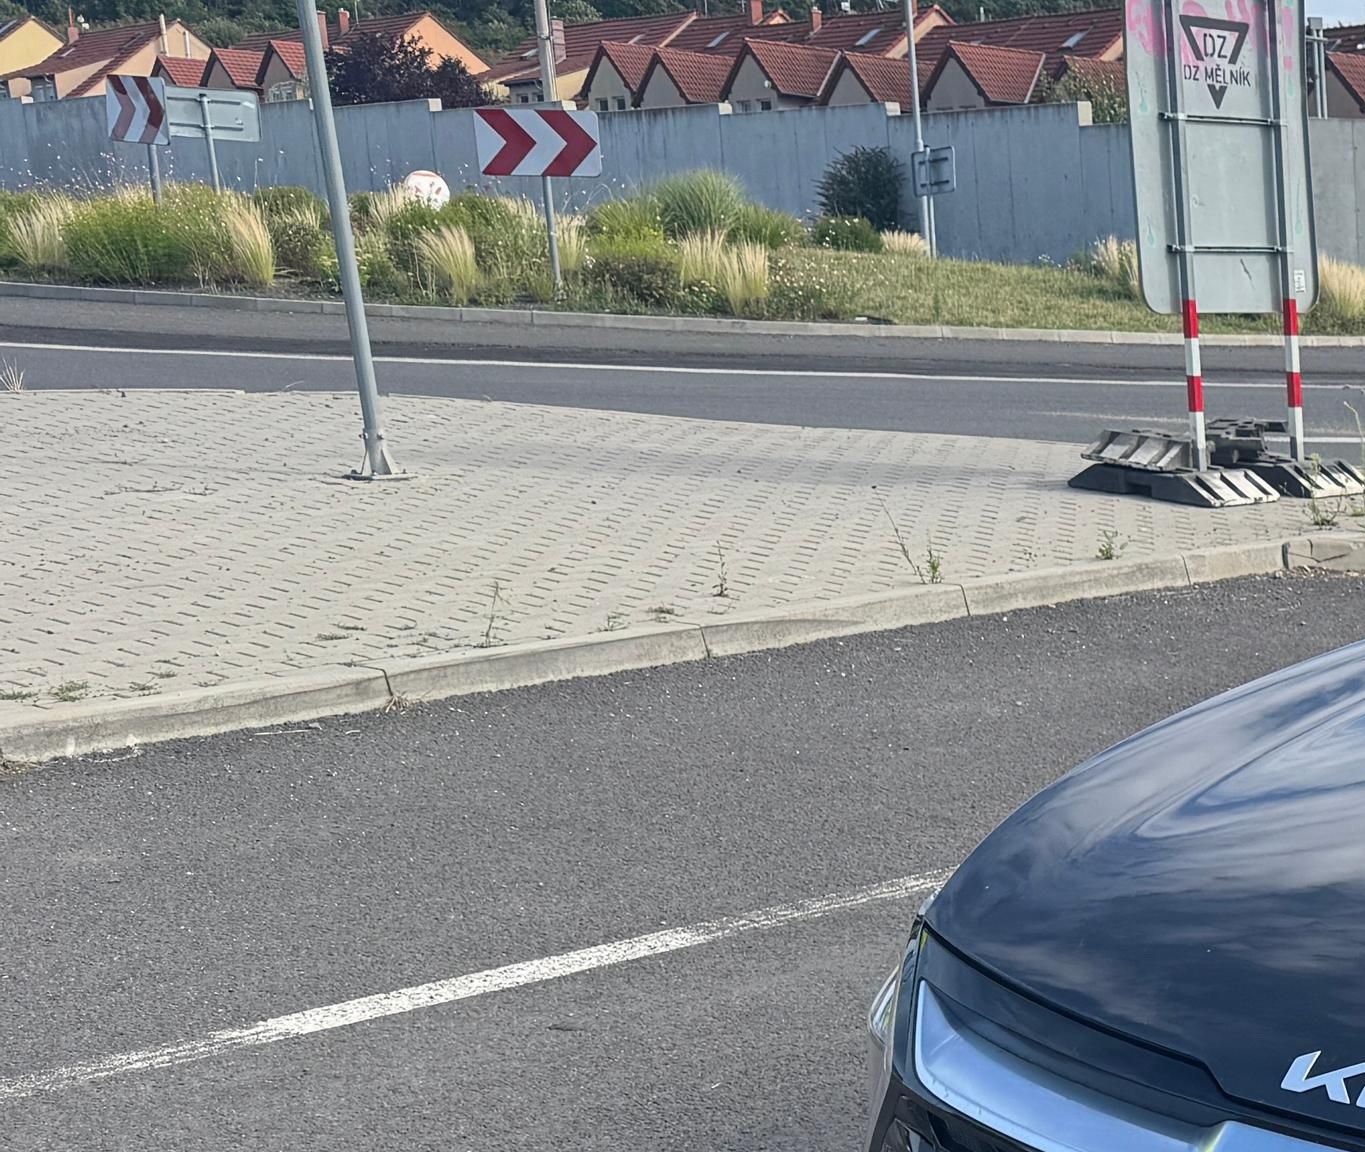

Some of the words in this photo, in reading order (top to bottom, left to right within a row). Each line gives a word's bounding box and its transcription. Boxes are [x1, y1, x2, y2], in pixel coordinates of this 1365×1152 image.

[1203, 33, 1228, 58] DZ
[1184, 64, 1200, 81] DZ
[1204, 63, 1251, 87] MĚLNÍK
